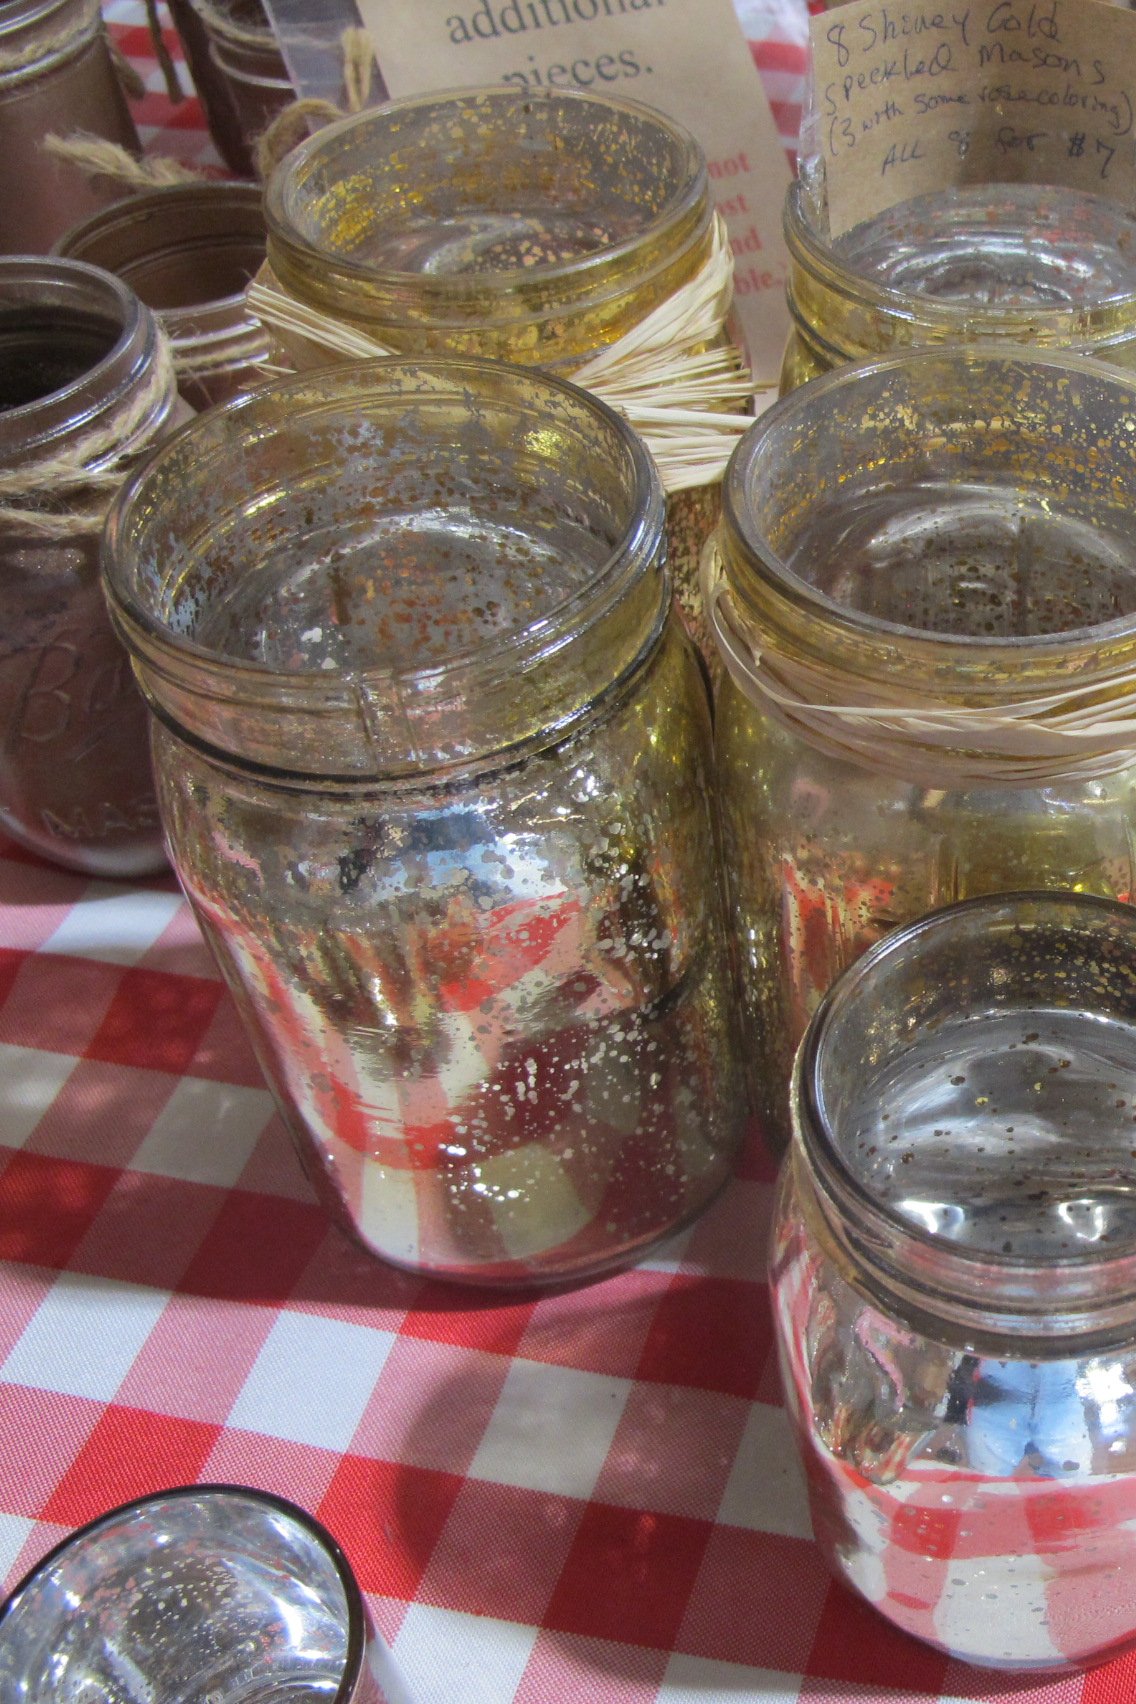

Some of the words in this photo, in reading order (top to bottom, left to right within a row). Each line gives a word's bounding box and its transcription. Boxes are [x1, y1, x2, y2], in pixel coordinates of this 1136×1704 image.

[446, 0, 665, 44] addition
[827, 24, 849, 67] 8
[862, 101, 904, 132] with
